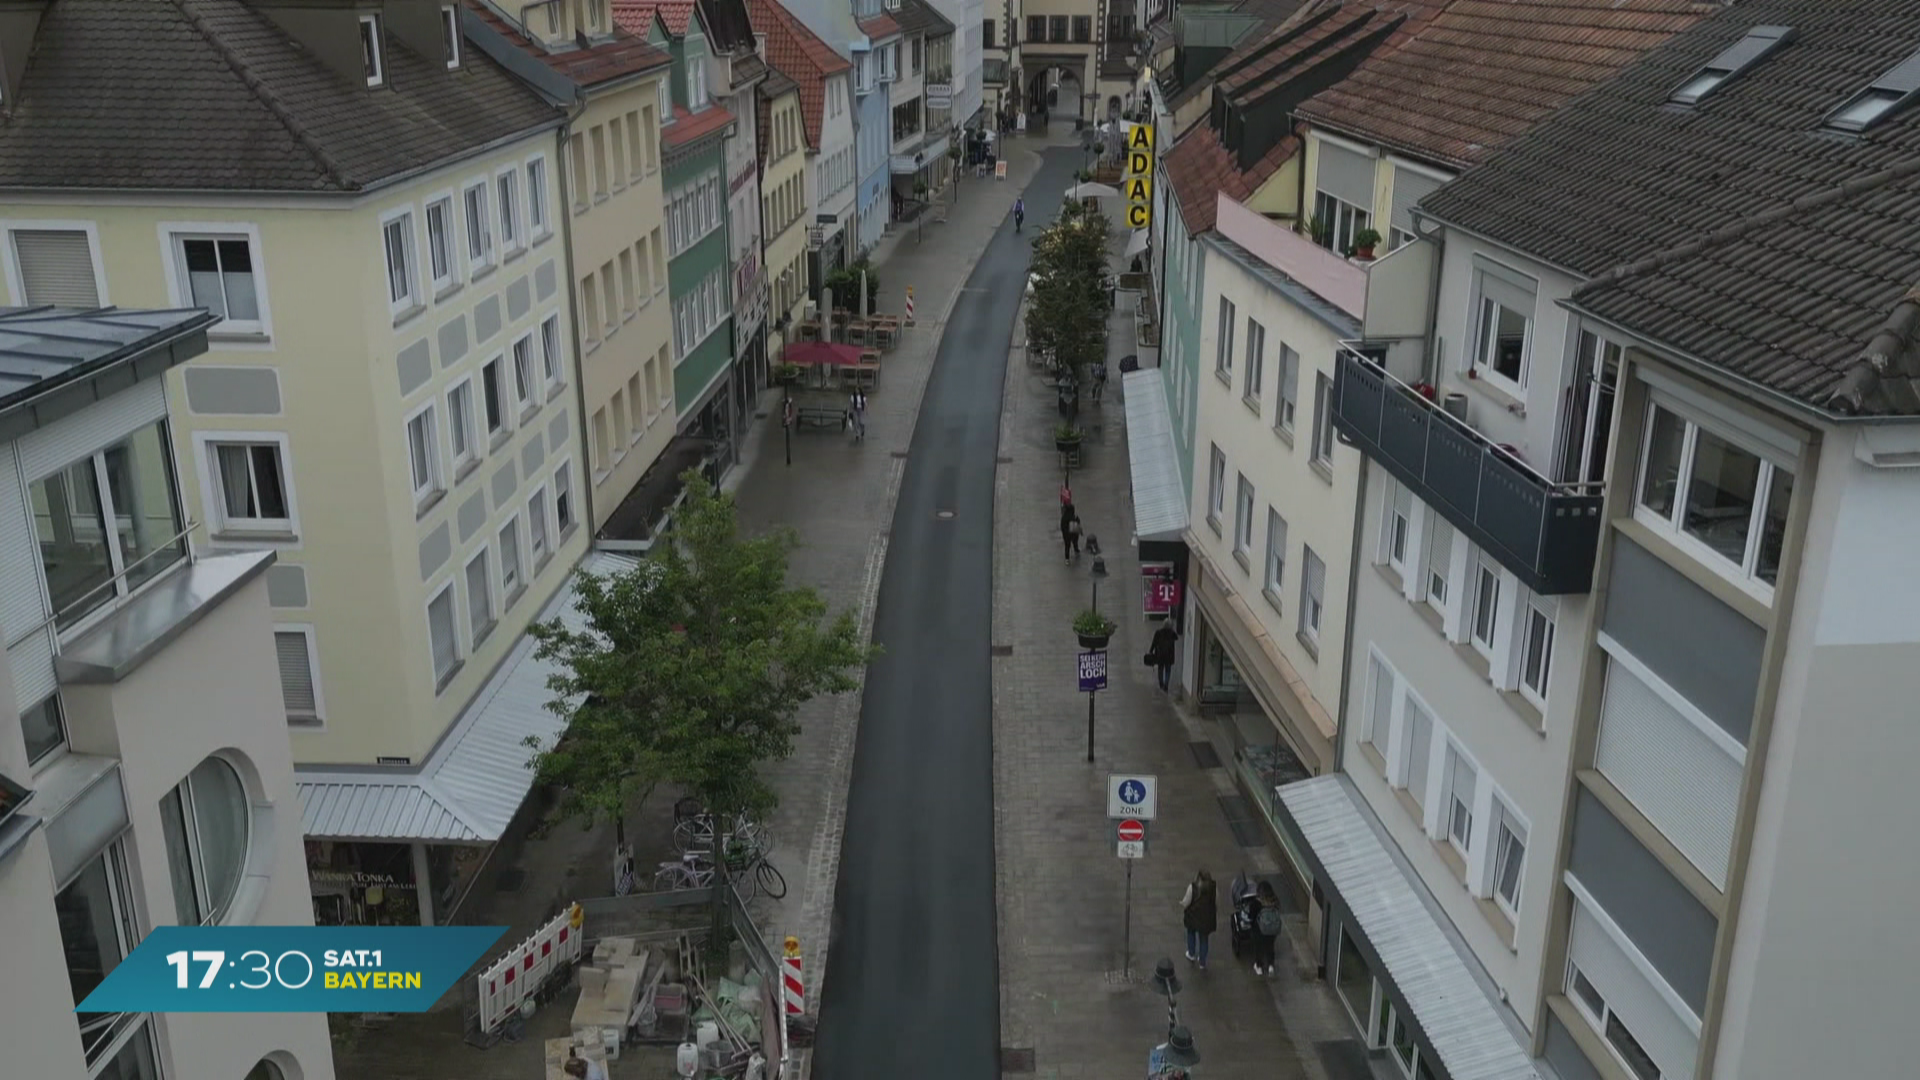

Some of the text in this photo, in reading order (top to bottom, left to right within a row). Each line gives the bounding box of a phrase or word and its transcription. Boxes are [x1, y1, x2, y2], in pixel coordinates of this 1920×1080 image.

[1130, 126, 1149, 226] ADAC
[1159, 584, 1175, 602] T
[1080, 660, 1106, 670] ARSCH
[1080, 667, 1106, 679] LOCH
[1120, 807, 1143, 815] ZONE
[355, 871, 394, 883] TONKA
